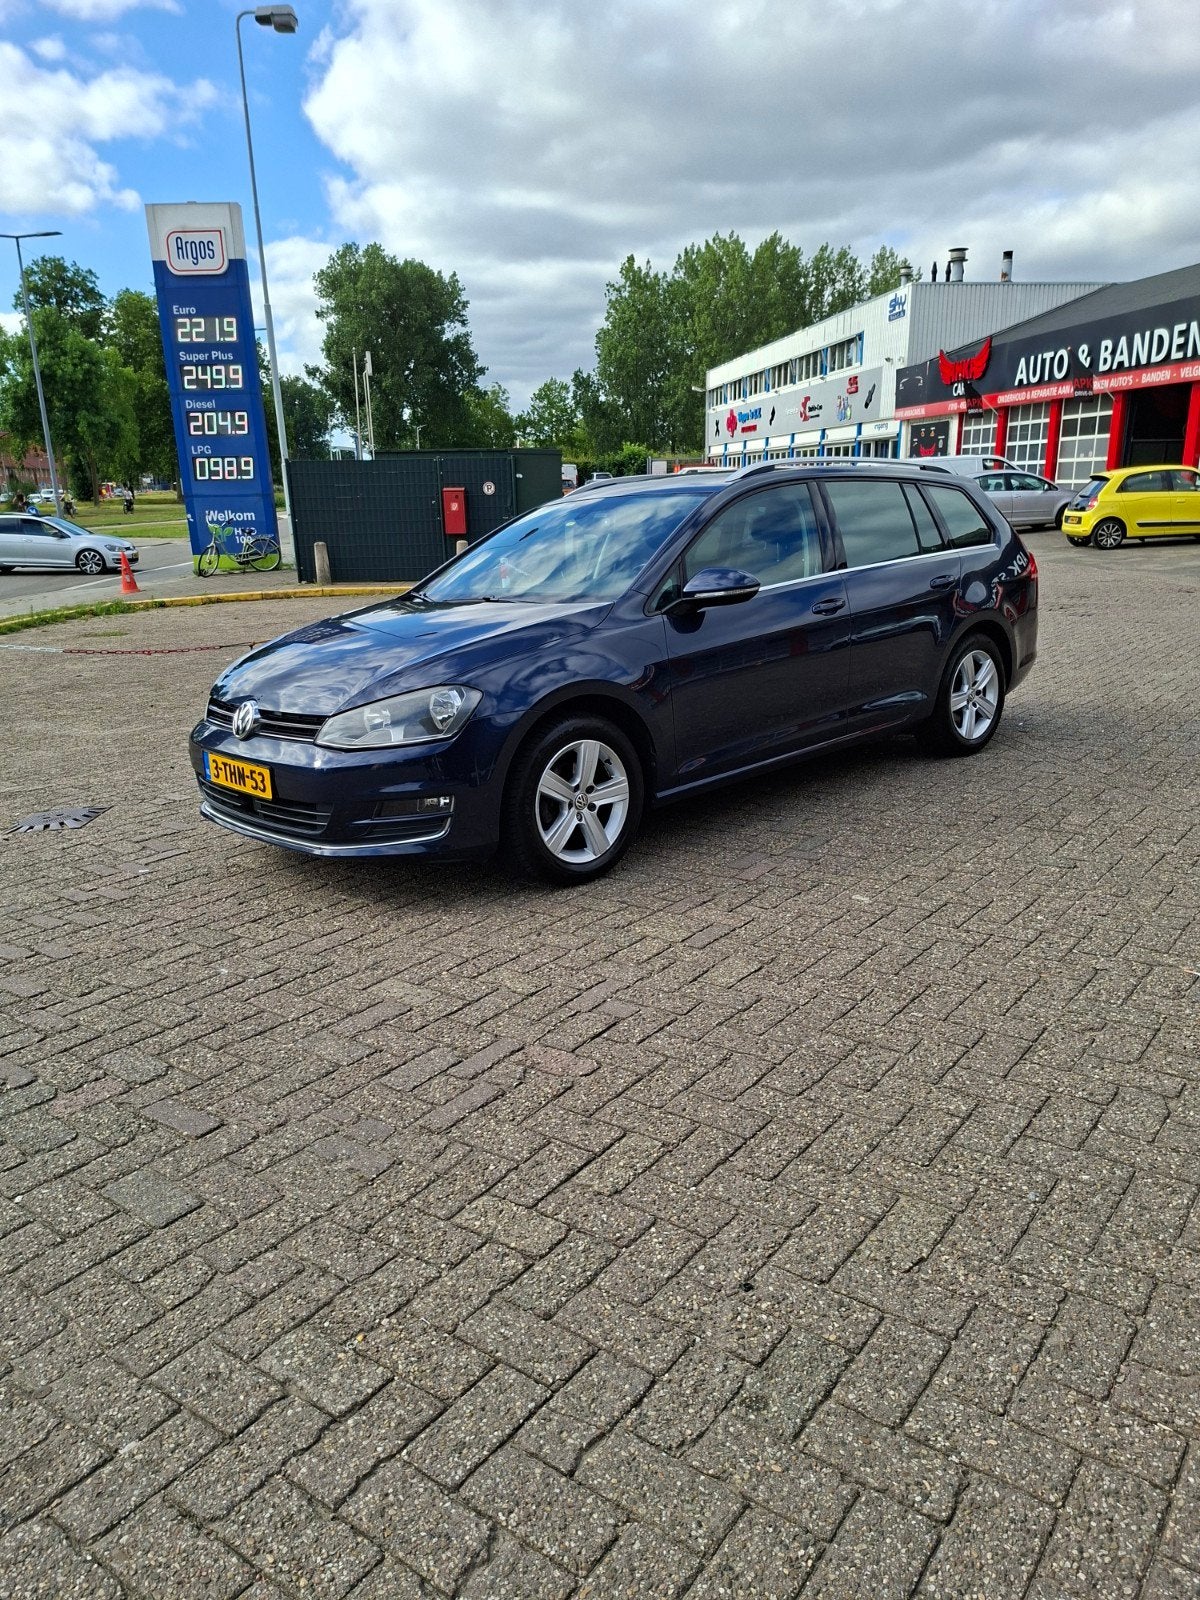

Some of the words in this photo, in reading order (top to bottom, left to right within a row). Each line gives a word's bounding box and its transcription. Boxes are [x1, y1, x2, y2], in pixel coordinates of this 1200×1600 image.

[175, 236, 215, 265] Argos
[173, 305, 196, 315] Euro
[177, 317, 237, 343] 221.9
[179, 351, 209, 363] Super
[211, 351, 233, 361] Plus
[1014, 349, 1069, 386] AUTO
[1078, 344, 1091, 368] &
[1099, 321, 1200, 372] BANDEN
[183, 365, 243, 389] 249.9
[997, 391, 1026, 404] ONDERHOUD
[1031, 387, 1057, 400] REPARATIE
[1058, 384, 1071, 396] AAN
[1109, 376, 1133, 388] AUTO'S
[1141, 370, 1171, 383] BANDEN
[1073, 378, 1093, 389] APK
[185, 400, 215, 409] Diesel
[189, 411, 248, 435] 204.9
[191, 445, 211, 455] LPG
[196, 457, 254, 480] 098.9
[205, 510, 256, 521] Welkom
[234, 527, 257, 536] HO
[212, 759, 267, 793] 3-THN-53
